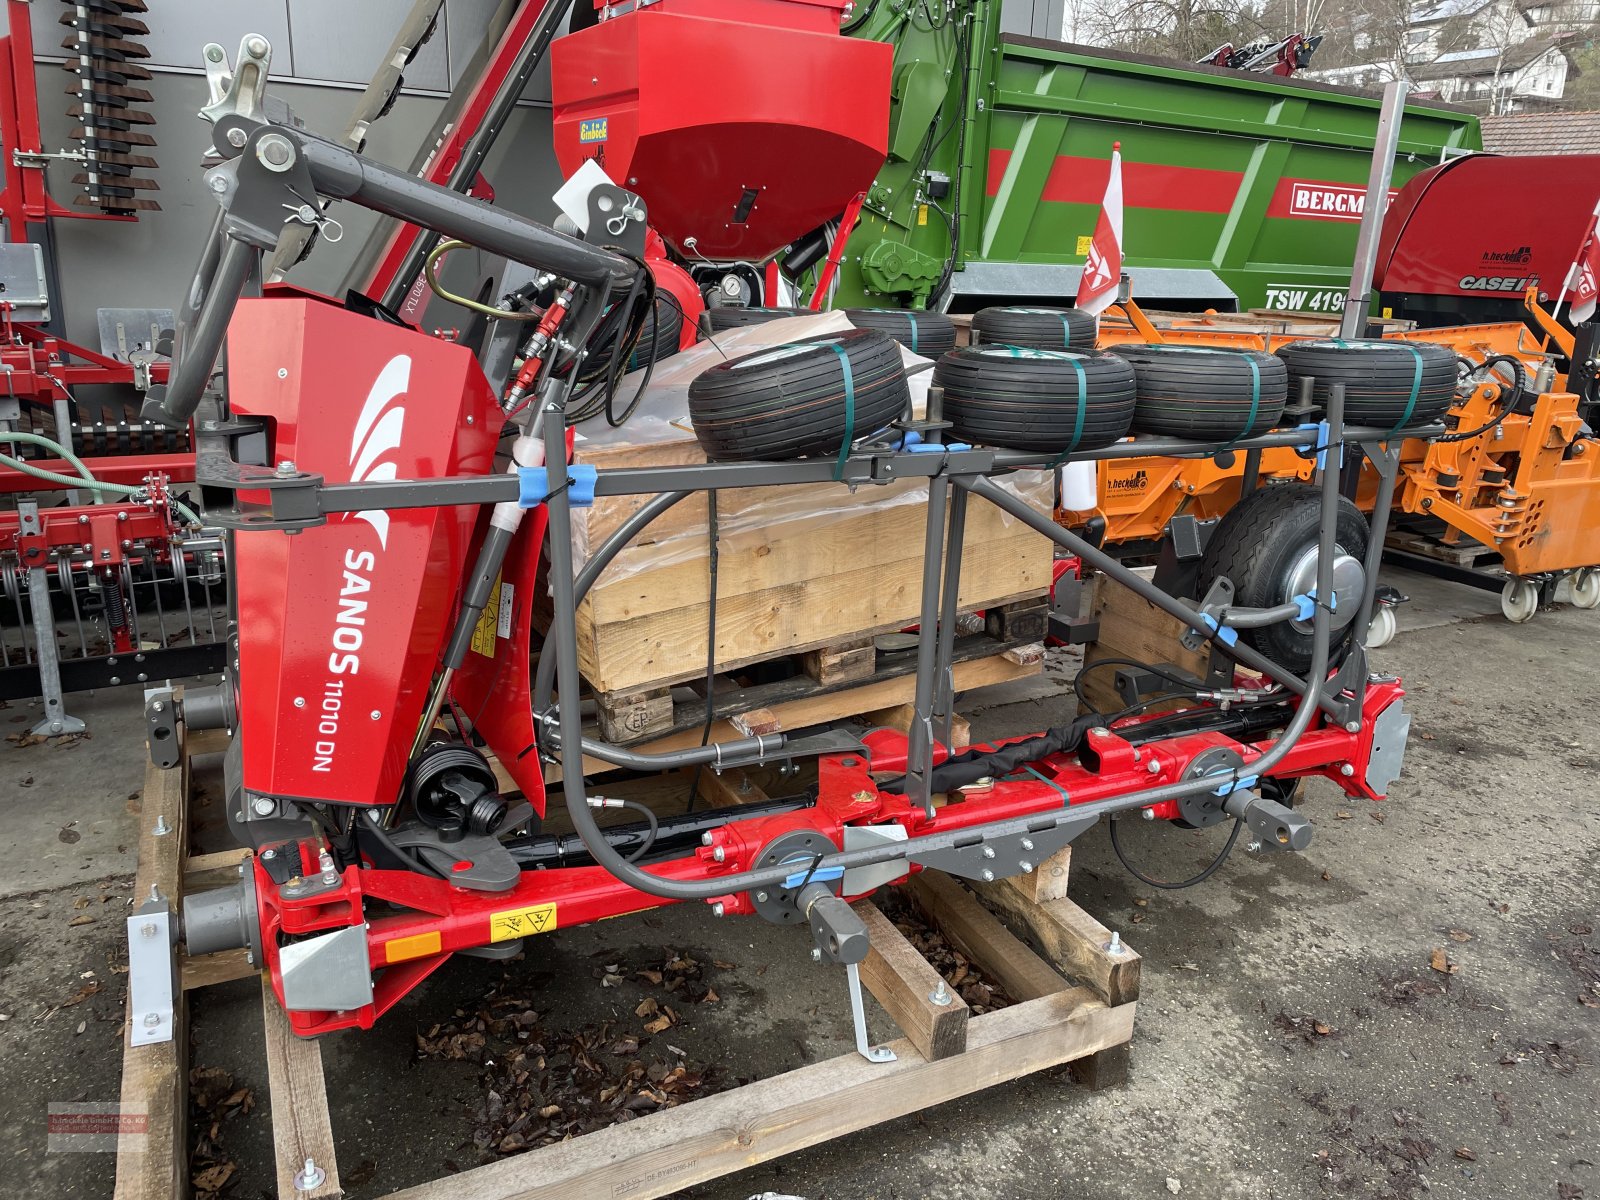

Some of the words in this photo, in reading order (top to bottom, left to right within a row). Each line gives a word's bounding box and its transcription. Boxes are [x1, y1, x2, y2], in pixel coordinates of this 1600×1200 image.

[1296, 190, 1394, 215] BERGM
[412, 276, 427, 297] 3670
[405, 297, 419, 314] TLX
[1265, 289, 1308, 310] TSW
[328, 548, 375, 675] SANOS
[318, 679, 344, 735] 11010
[312, 741, 336, 772] DN
